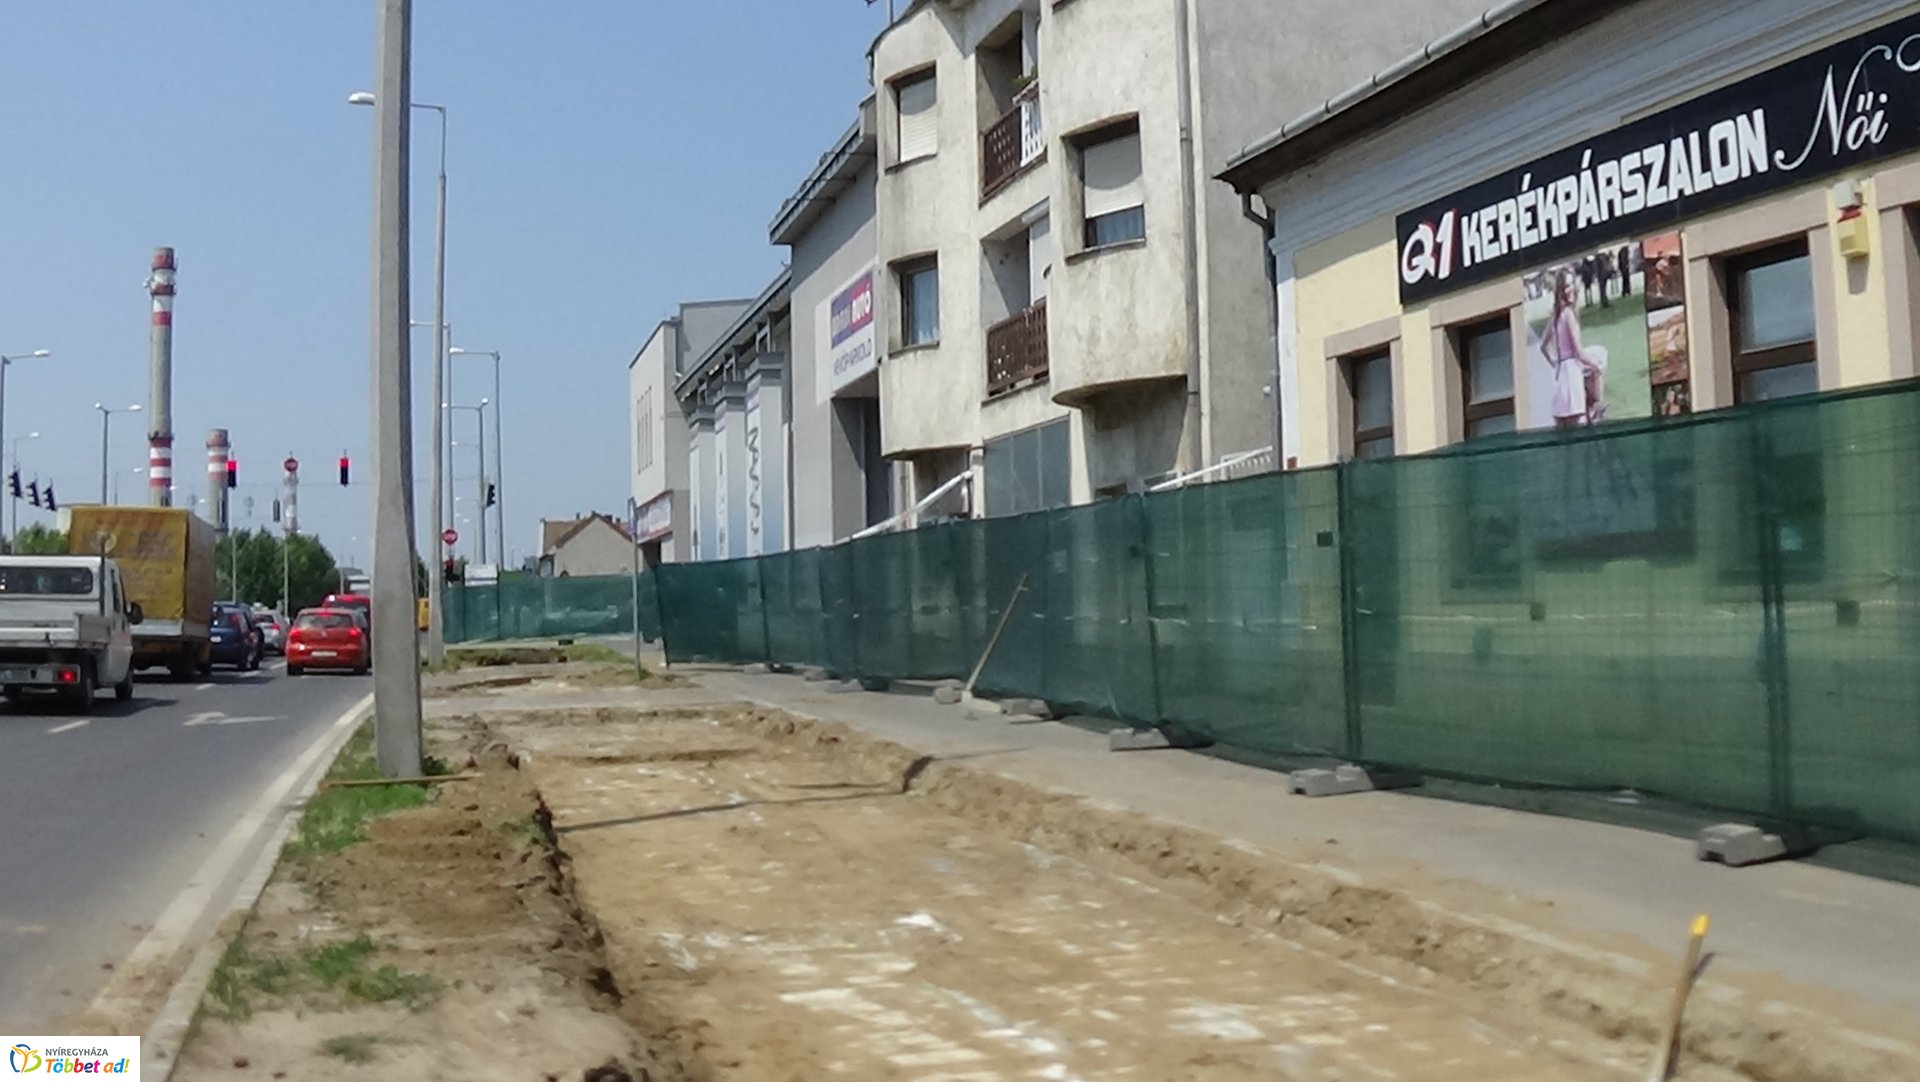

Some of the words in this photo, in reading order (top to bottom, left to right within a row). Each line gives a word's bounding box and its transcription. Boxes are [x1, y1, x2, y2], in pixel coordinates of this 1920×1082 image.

[1402, 211, 1455, 284] Q1
[1461, 108, 1768, 267] KERÉKPÁRSZALON
[1774, 45, 1893, 170] Női
